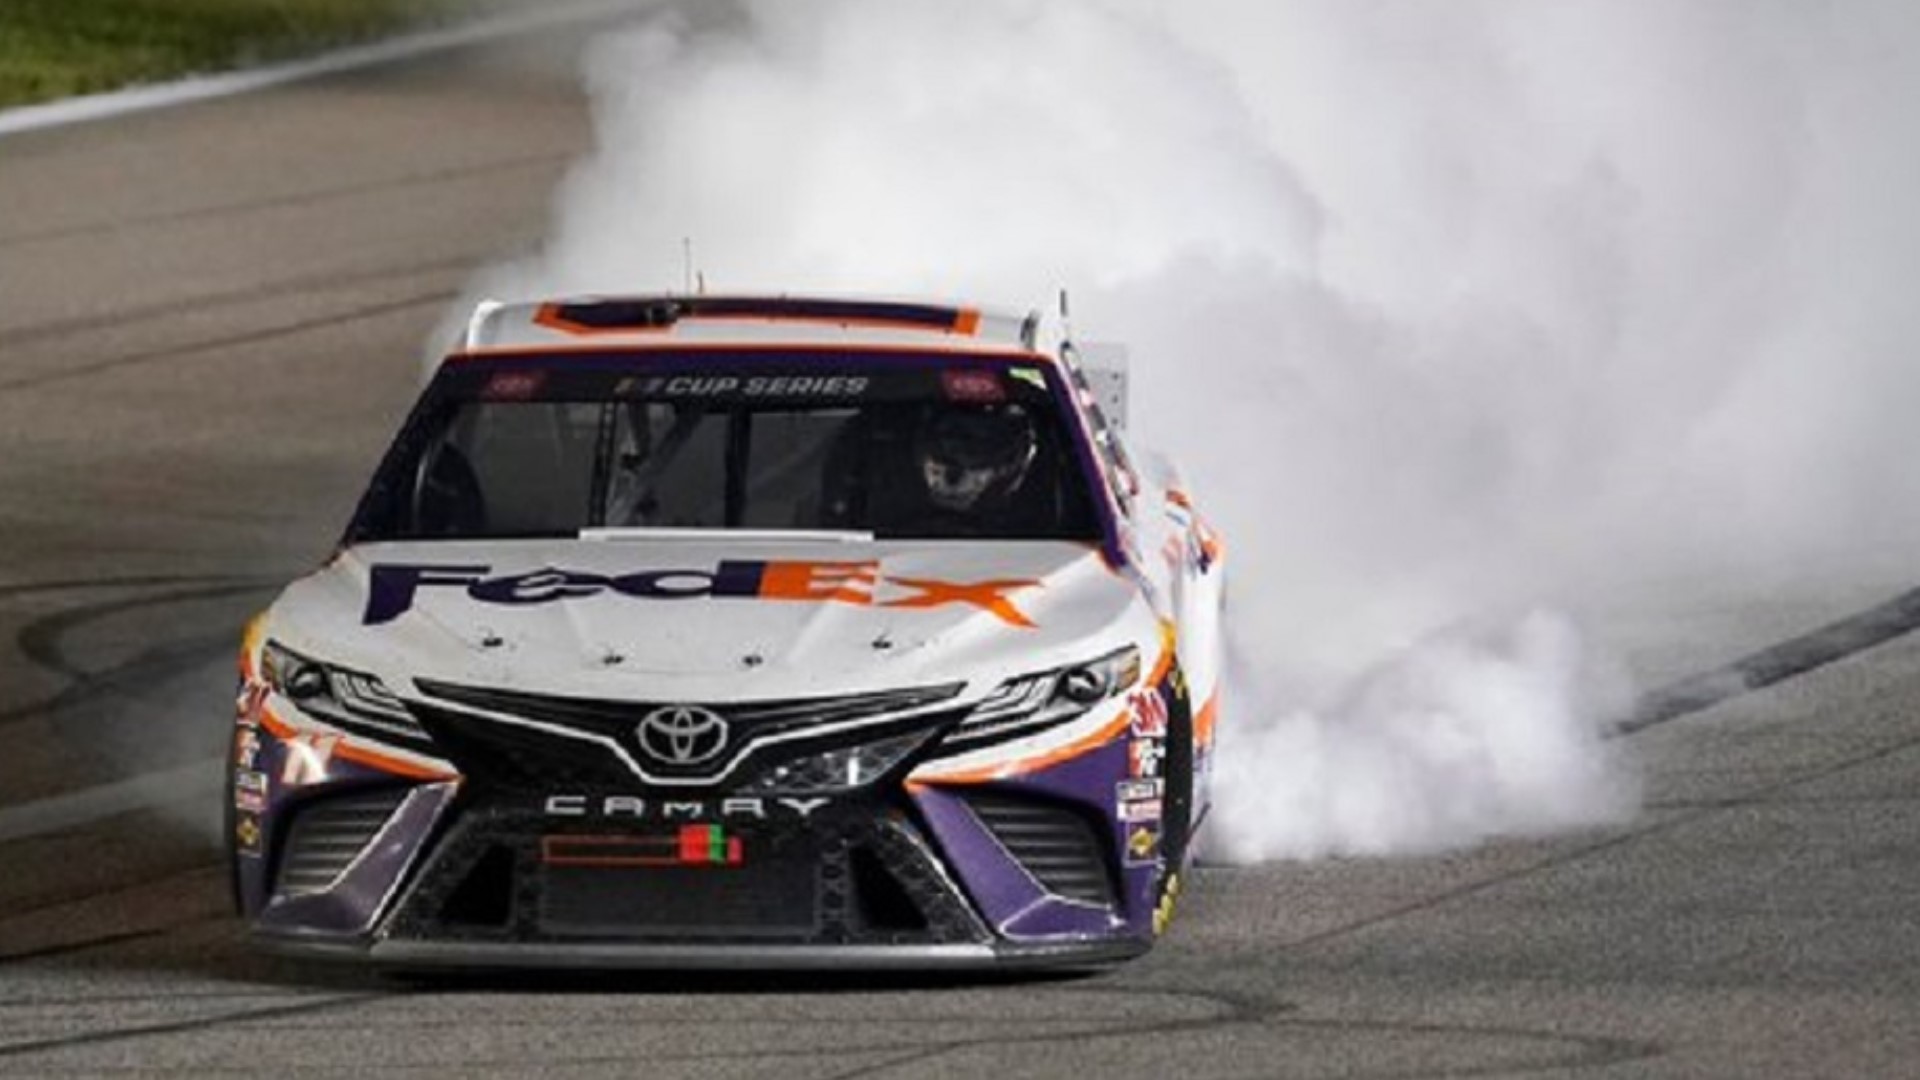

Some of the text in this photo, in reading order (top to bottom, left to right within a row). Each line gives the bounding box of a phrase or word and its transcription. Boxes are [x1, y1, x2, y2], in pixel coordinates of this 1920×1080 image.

[665, 377, 868, 396] CUP SERIES
[363, 560, 1041, 626] FedEx
[545, 796, 830, 818] CAMRY
